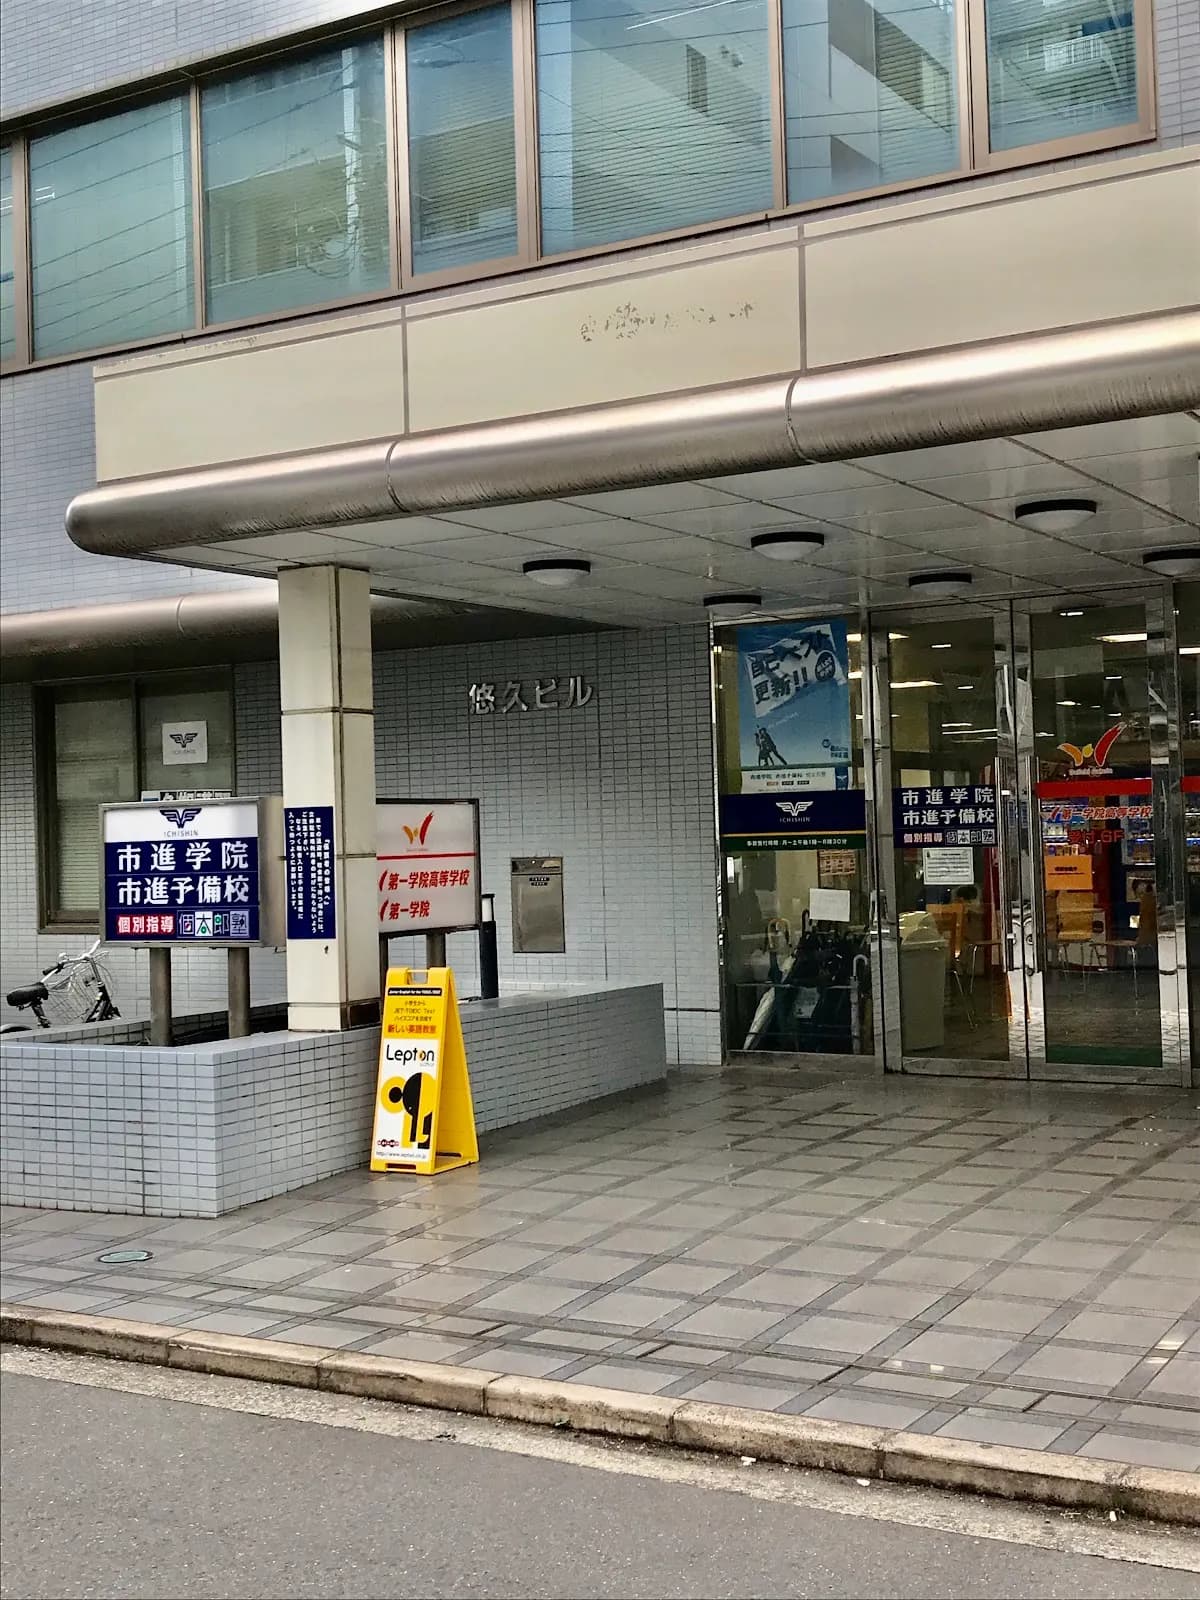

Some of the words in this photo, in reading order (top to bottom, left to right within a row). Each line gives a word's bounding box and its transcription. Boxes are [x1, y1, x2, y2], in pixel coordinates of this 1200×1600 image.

[468, 675, 593, 715] 悠久ビル
[902, 787, 994, 806] 市進学院
[779, 816, 811, 824] ICHISHIN
[902, 807, 995, 826] 市進予備校
[1062, 805, 1153, 820] 第一学院高等学校
[163, 829, 199, 839] ICHISHIN
[903, 832, 943, 844] 個別指導
[117, 840, 250, 873] 市進学院
[388, 869, 470, 891] 第一学院高等学校
[117, 875, 250, 906] 市進予備校
[388, 900, 430, 920] 第一学院
[117, 914, 175, 934] 個別指導
[178, 910, 250, 937] 個太郎塾
[388, 1024, 437, 1034] 新しい英語教室
[386, 1043, 435, 1066] Lepton
